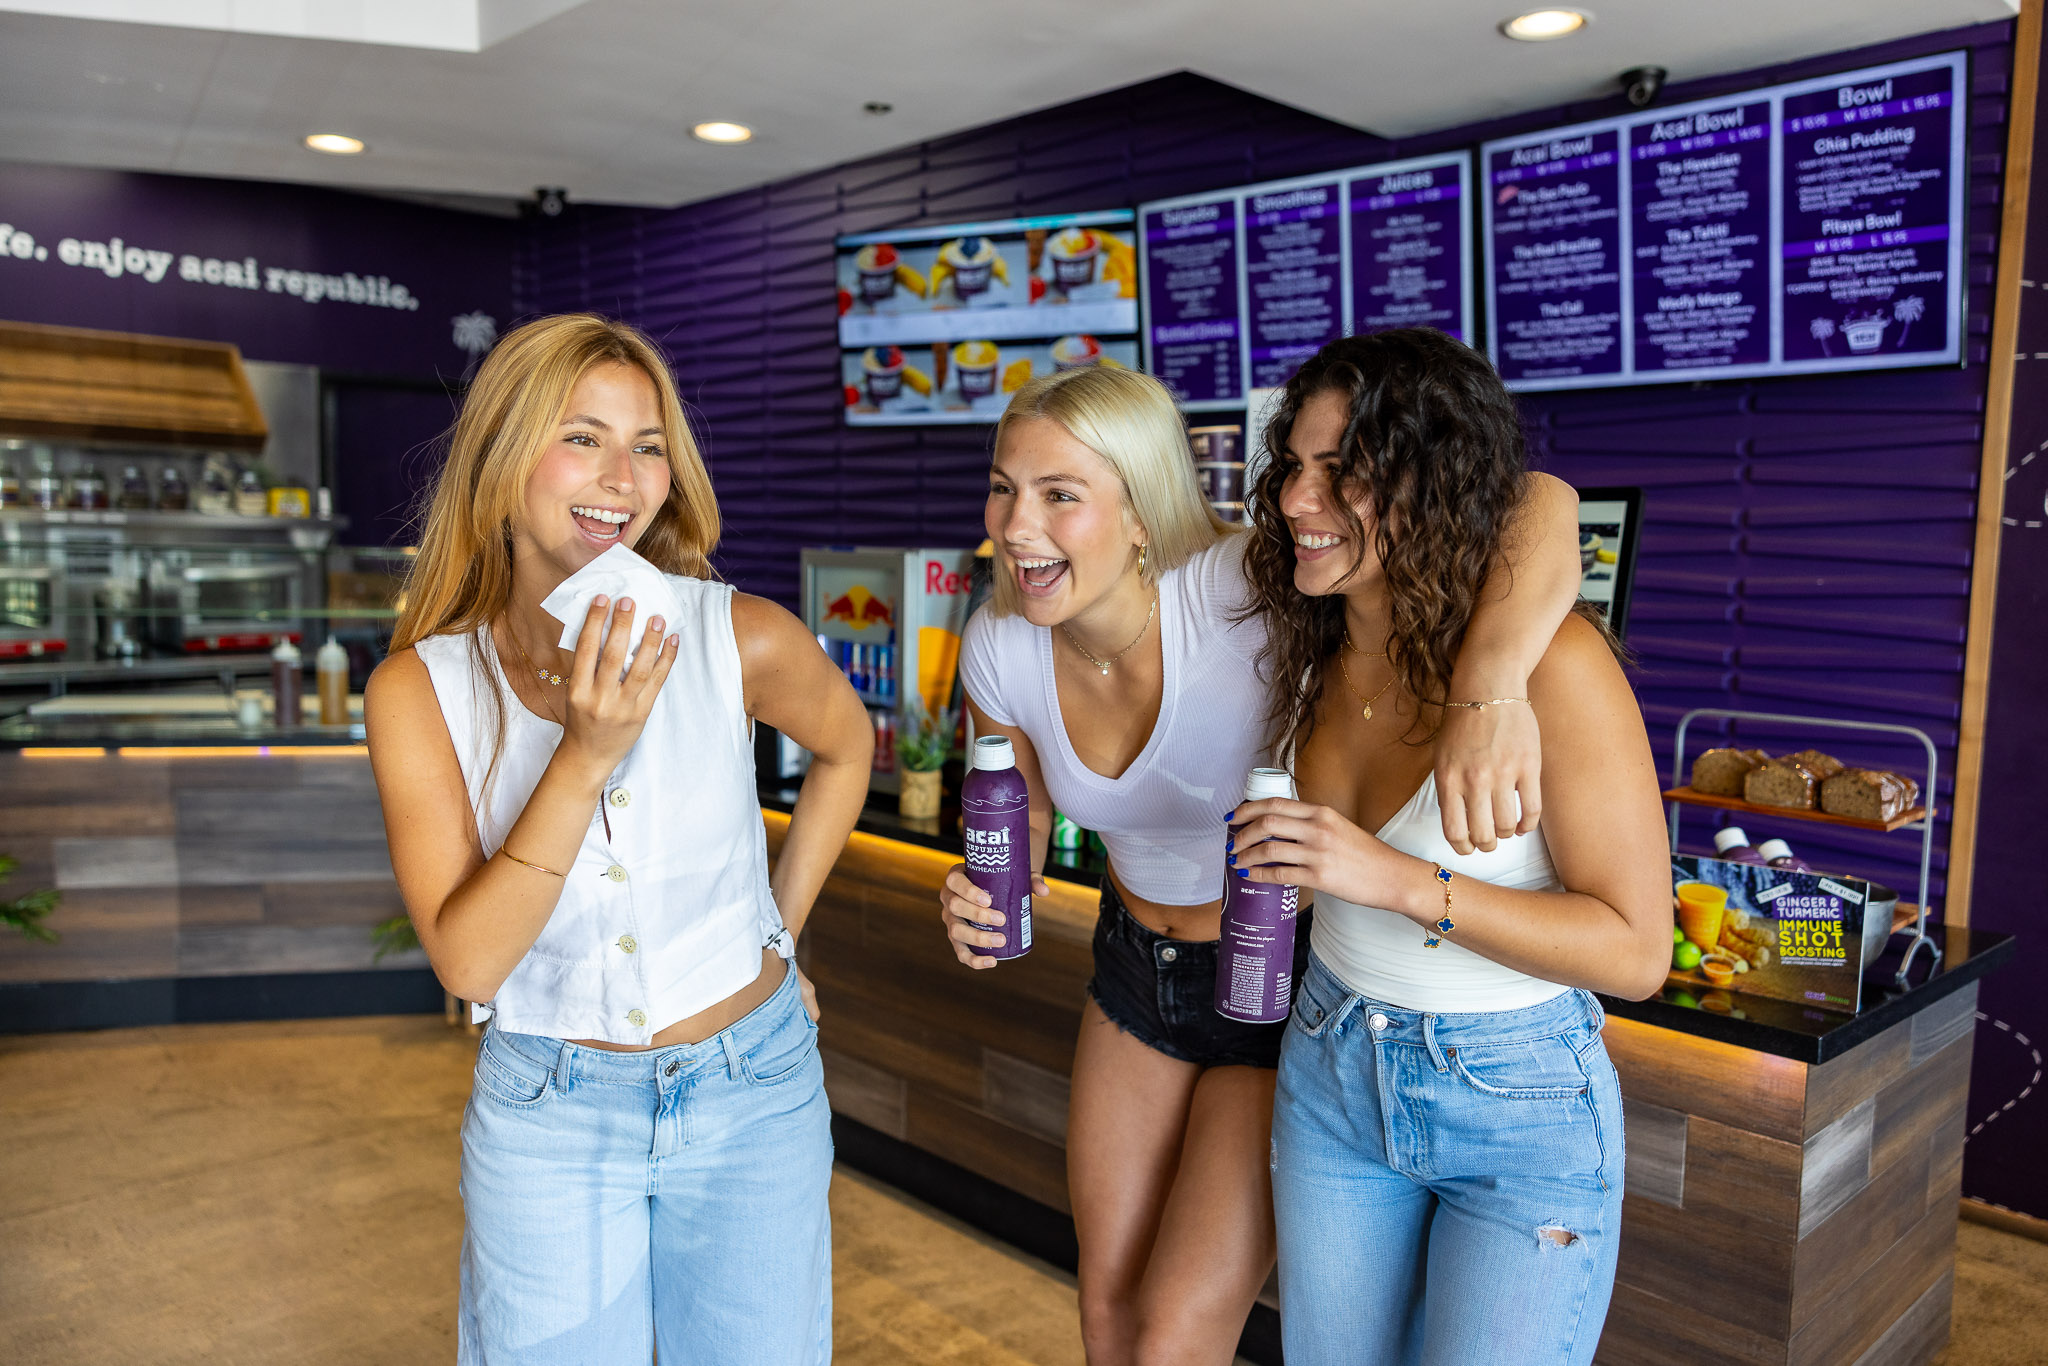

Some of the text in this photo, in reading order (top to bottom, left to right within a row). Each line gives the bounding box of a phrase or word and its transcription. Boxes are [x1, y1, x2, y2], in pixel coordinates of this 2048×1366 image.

[1838, 79, 1893, 108] Bowl
[1695, 106, 1744, 134] Bowl
[1549, 135, 1593, 160] Bowl
[1813, 126, 1916, 155] Chia Pudding
[1822, 210, 1902, 236] Pitaya Bowl
[57, 235, 174, 284] enjoy
[179, 257, 260, 291] acai
[265, 265, 419, 310] republic.
[966, 842, 1010, 853] REPUBLIC
[967, 862, 1010, 873] STAYHEALTHY
[1775, 896, 1839, 908] GINGER &
[1776, 907, 1840, 919] TURMERIC
[1778, 920, 1843, 932] IMMUNE
[1779, 931, 1844, 947] SHOT
[1780, 946, 1846, 958] BOOSTING
